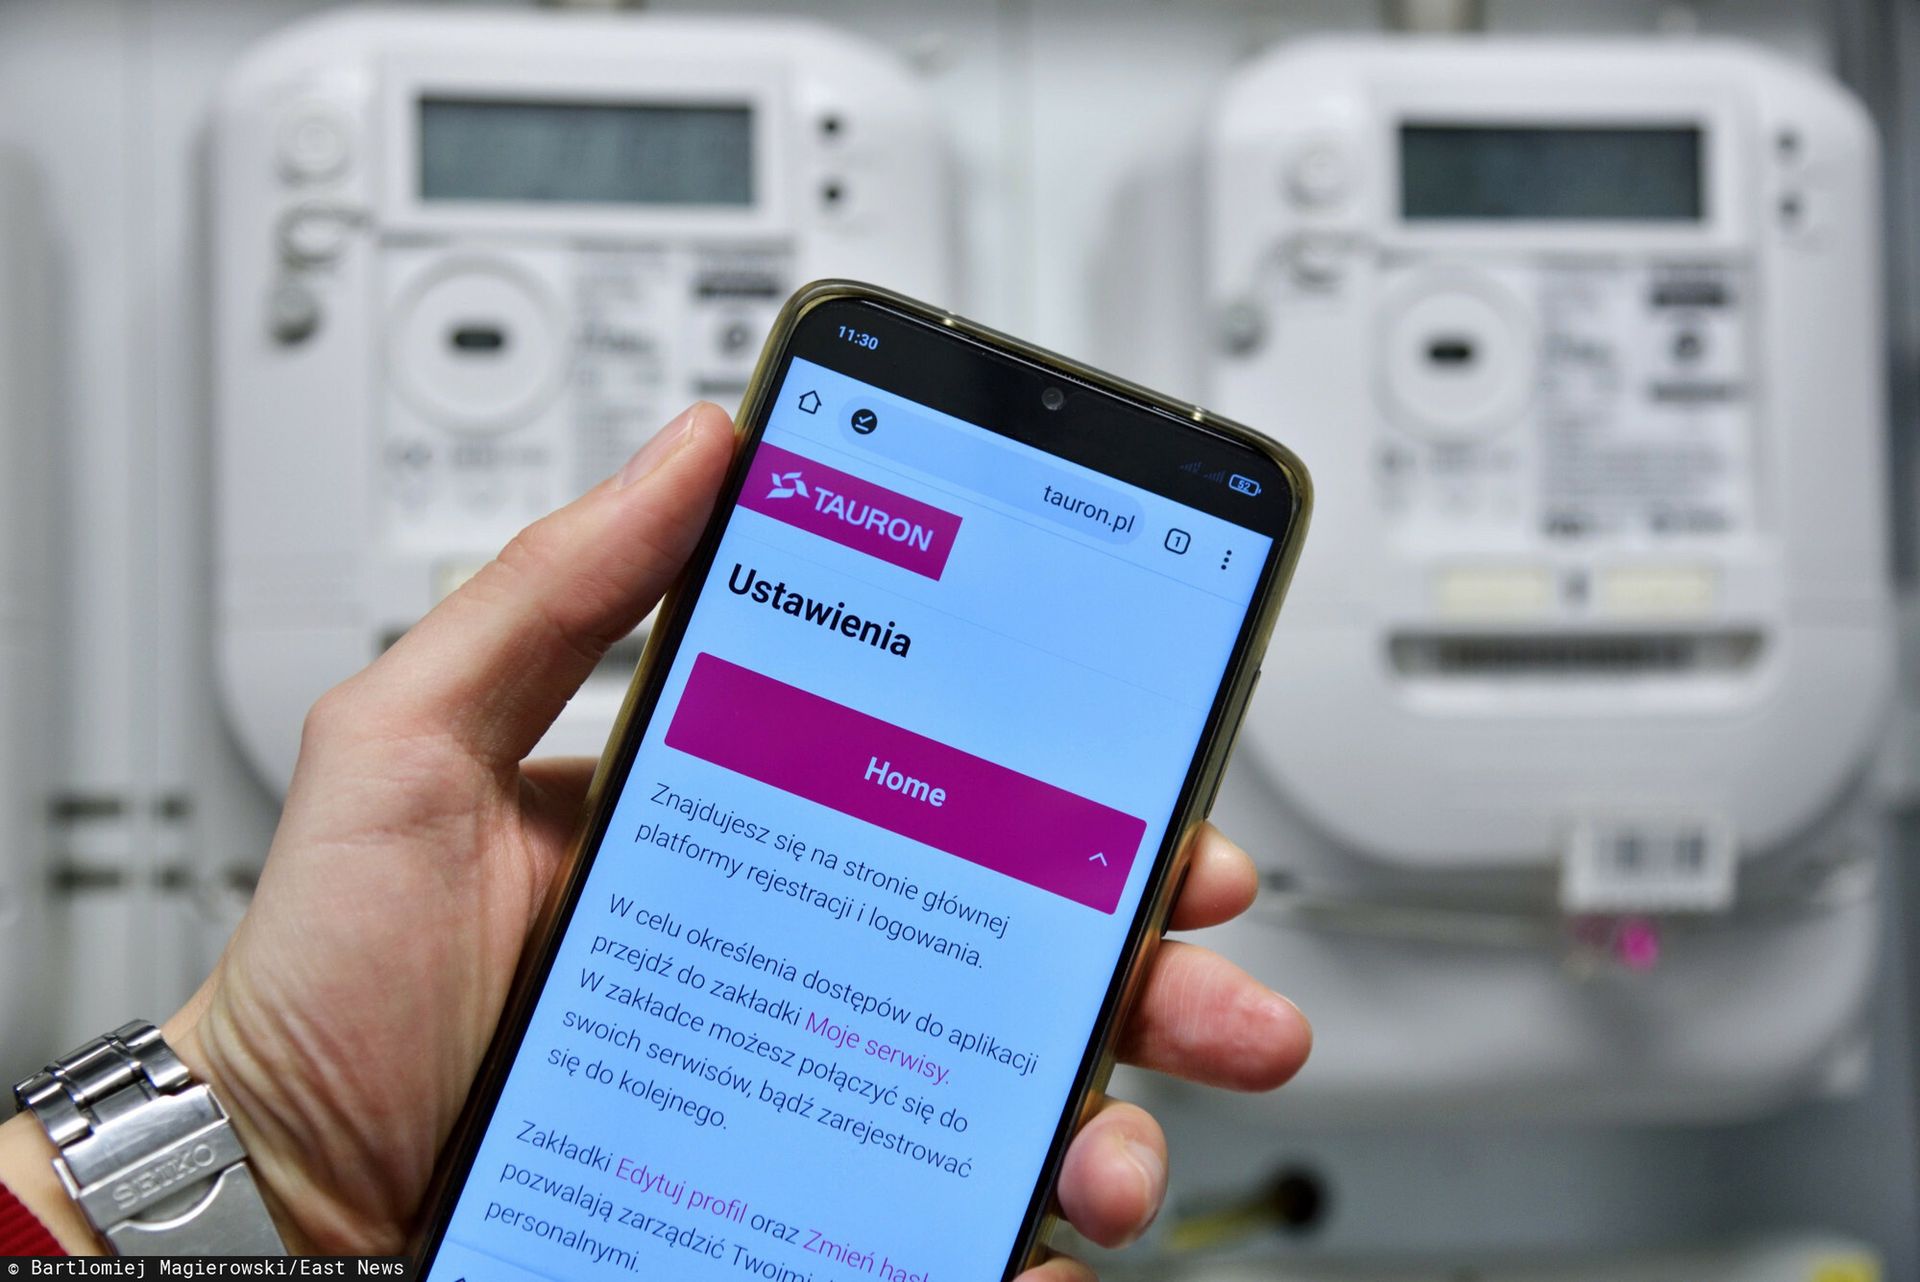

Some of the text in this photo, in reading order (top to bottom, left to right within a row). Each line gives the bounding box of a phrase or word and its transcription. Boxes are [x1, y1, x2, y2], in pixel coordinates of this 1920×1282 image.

[838, 325, 879, 350] 11:30
[814, 486, 934, 552] TAURON
[1043, 484, 1136, 534] tauron.pl
[727, 563, 912, 658] Ustawienia
[864, 756, 946, 807] Home
[634, 823, 982, 968] platformy rejestracji i logowania.
[650, 782, 1009, 940] Znajdujesz się na stronie głównej
[590, 935, 950, 1086] przejdź do zakładki Moje serwisy.
[610, 893, 1038, 1077] W celu określenia dostępów do aplikacji
[547, 1048, 727, 1129] się do kolejnego.
[562, 1011, 972, 1178] swoich serwisów, bądź zarejestrować
[580, 967, 968, 1133] W zakładce możesz połączyć się do
[112, 1143, 215, 1209] SEIKO
[499, 1162, 614, 1223] pozwalają
[617, 1207, 726, 1260] zarządzić
[516, 1120, 612, 1173] Zakładki
[615, 1157, 685, 1205] Edytuj
[686, 1189, 748, 1224] profil
[750, 1214, 800, 1245] oraz
[802, 1229, 875, 1273] Zmień
[484, 1201, 639, 1273] personalnymi.
